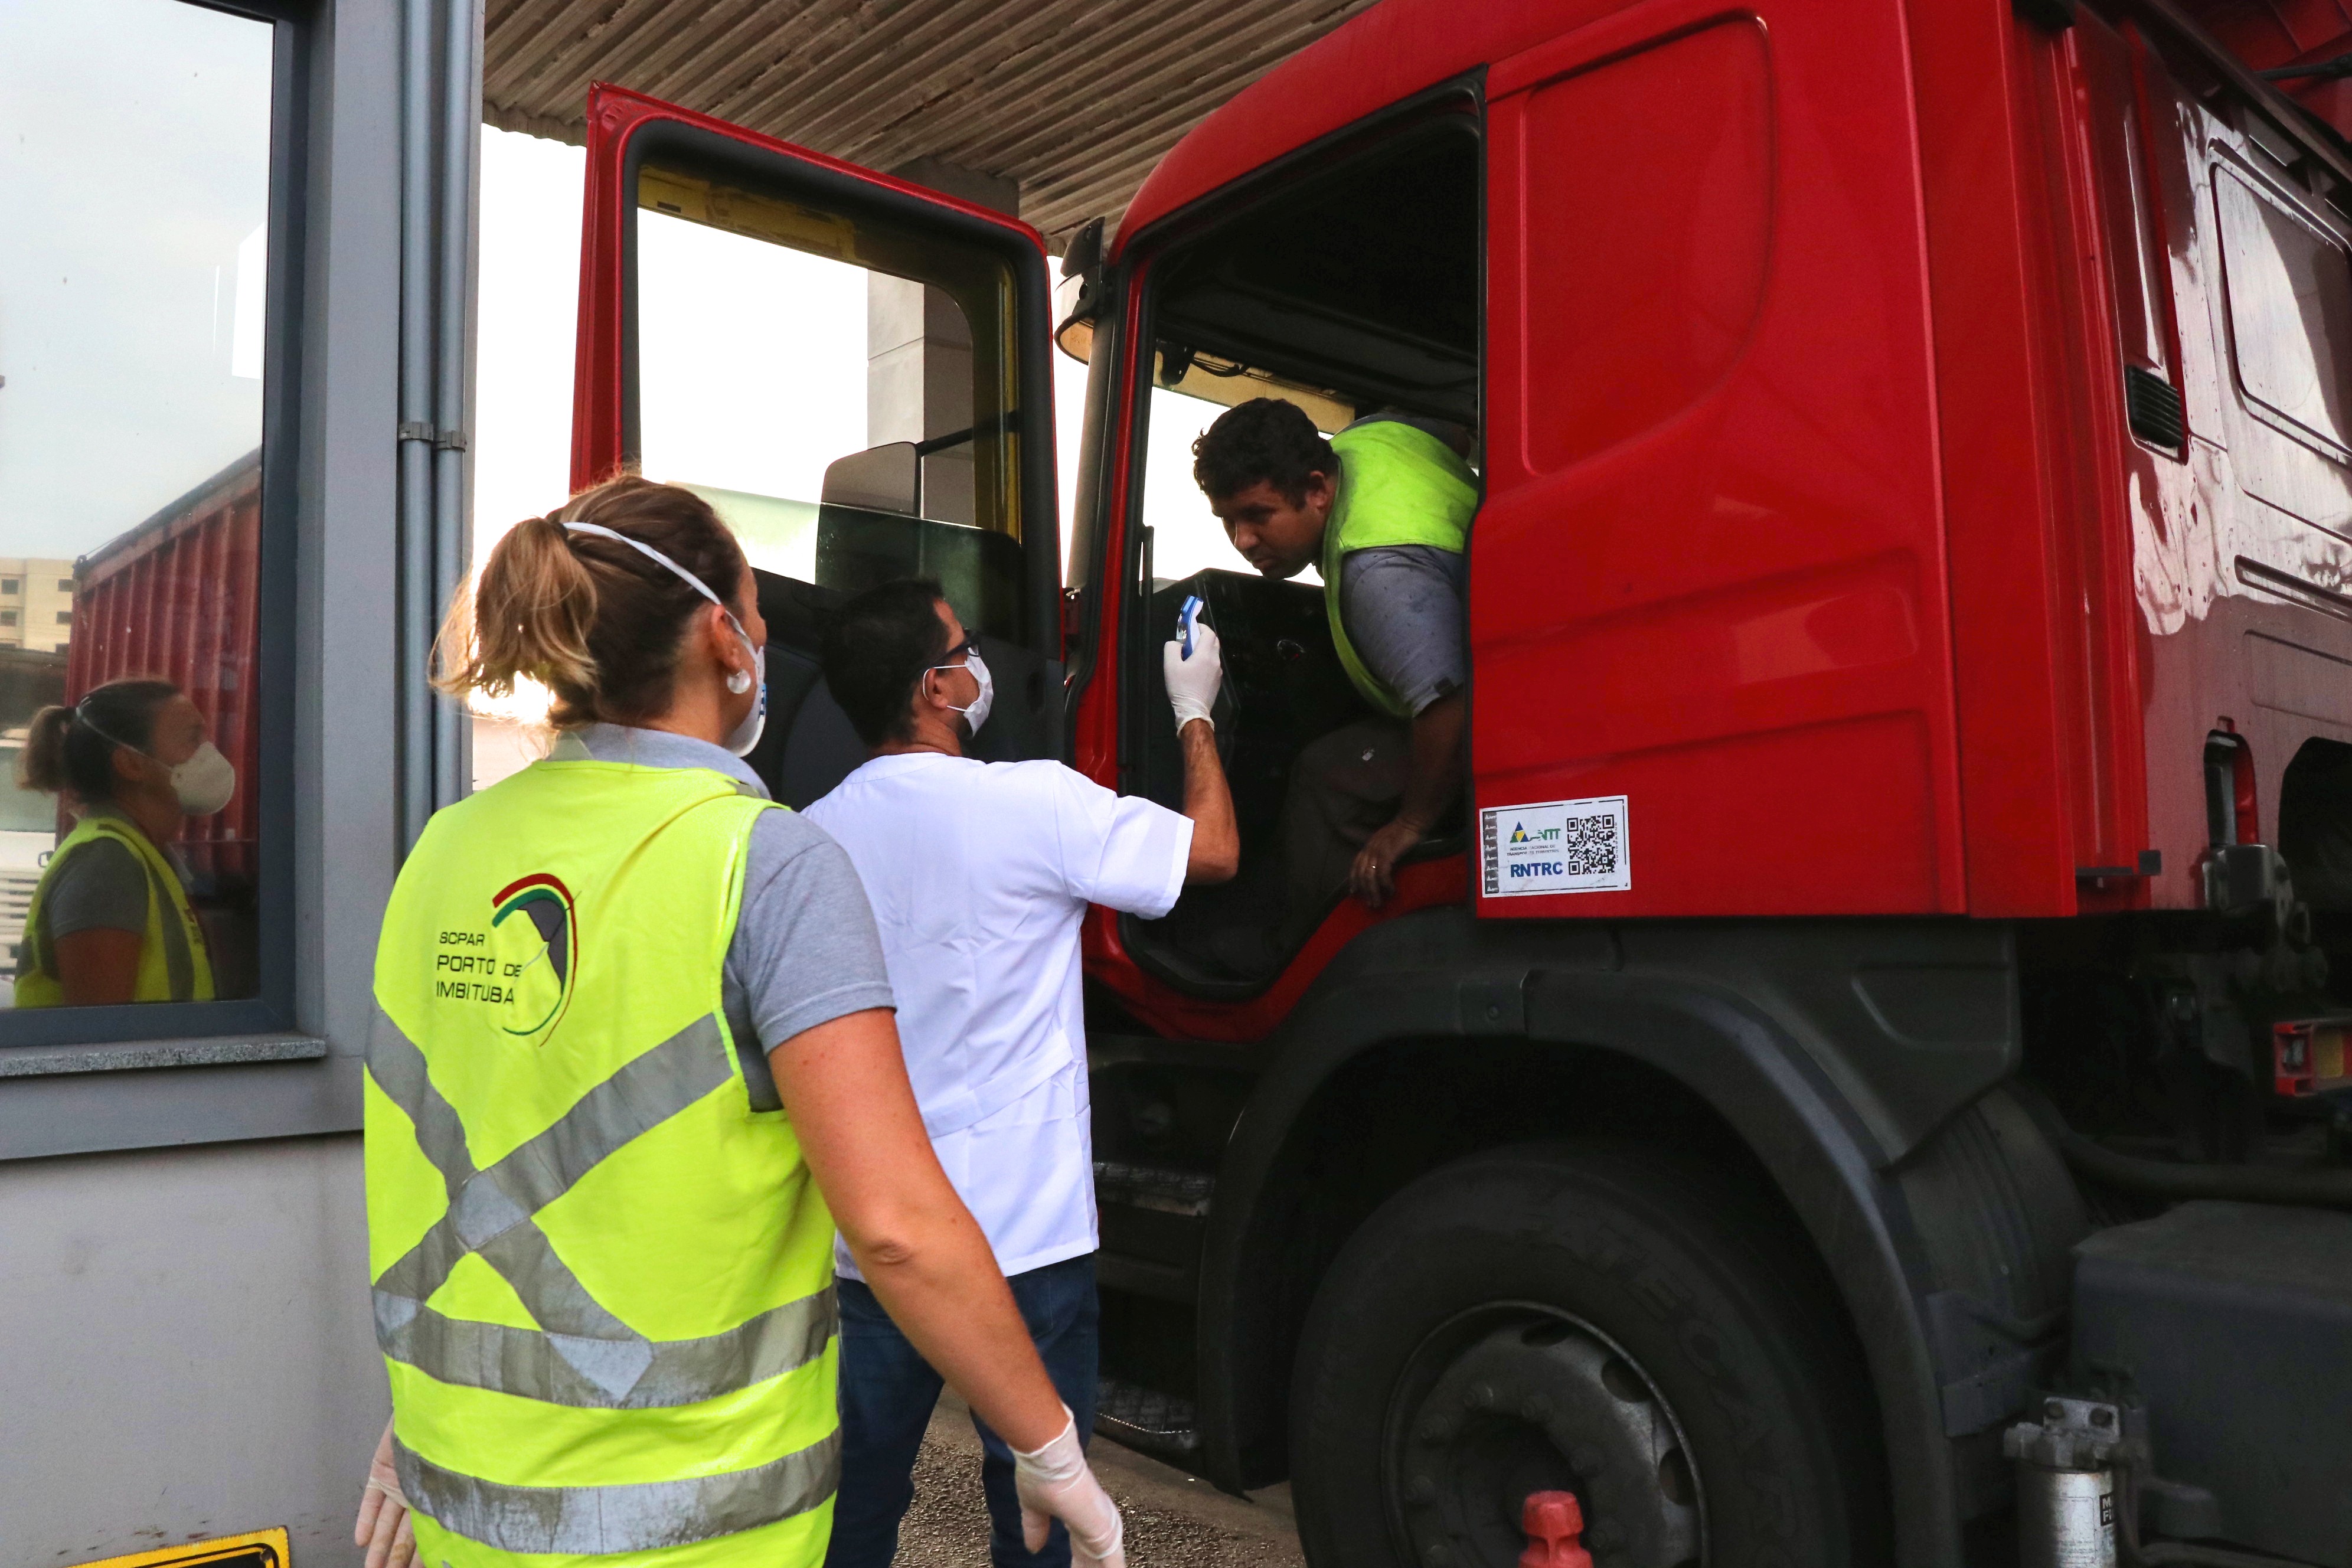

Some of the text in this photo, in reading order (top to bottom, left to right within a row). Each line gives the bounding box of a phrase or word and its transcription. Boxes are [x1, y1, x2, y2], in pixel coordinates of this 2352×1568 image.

[1510, 861, 1563, 878] RNTRC
[439, 932, 485, 946] SCPAR
[437, 955, 522, 977] PORTO DE
[436, 981, 514, 1005] IMBITUBA
